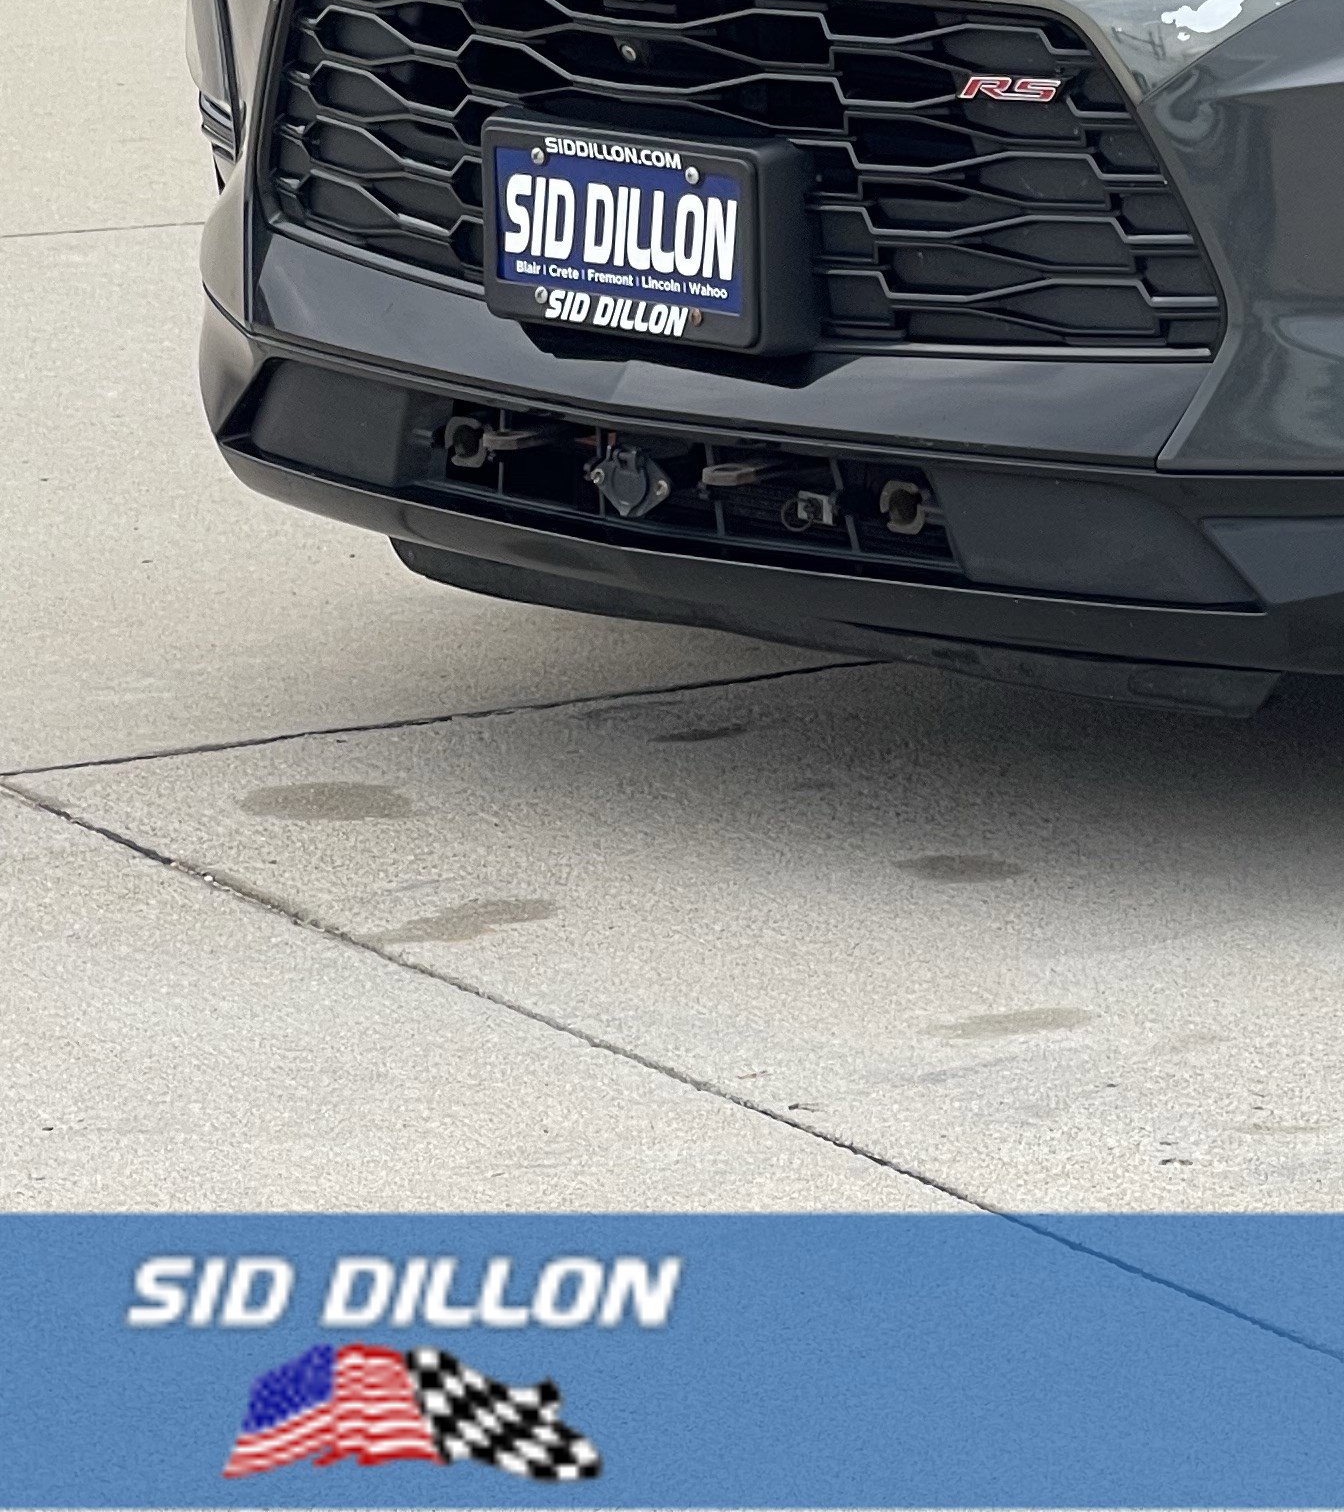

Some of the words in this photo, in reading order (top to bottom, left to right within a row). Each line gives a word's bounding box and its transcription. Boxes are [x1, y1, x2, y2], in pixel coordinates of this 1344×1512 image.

[958, 76, 1062, 103] RS
[544, 136, 683, 171] SIDDILLON.COM
[504, 172, 576, 261] SID
[582, 181, 738, 282] DILLON
[515, 259, 542, 276] Blair
[548, 264, 580, 281] Crete
[586, 268, 634, 288] Fremont
[641, 277, 681, 293] Lincoln
[688, 281, 729, 300] Wahoo
[544, 288, 591, 324] SID
[592, 294, 689, 338] DILLON
